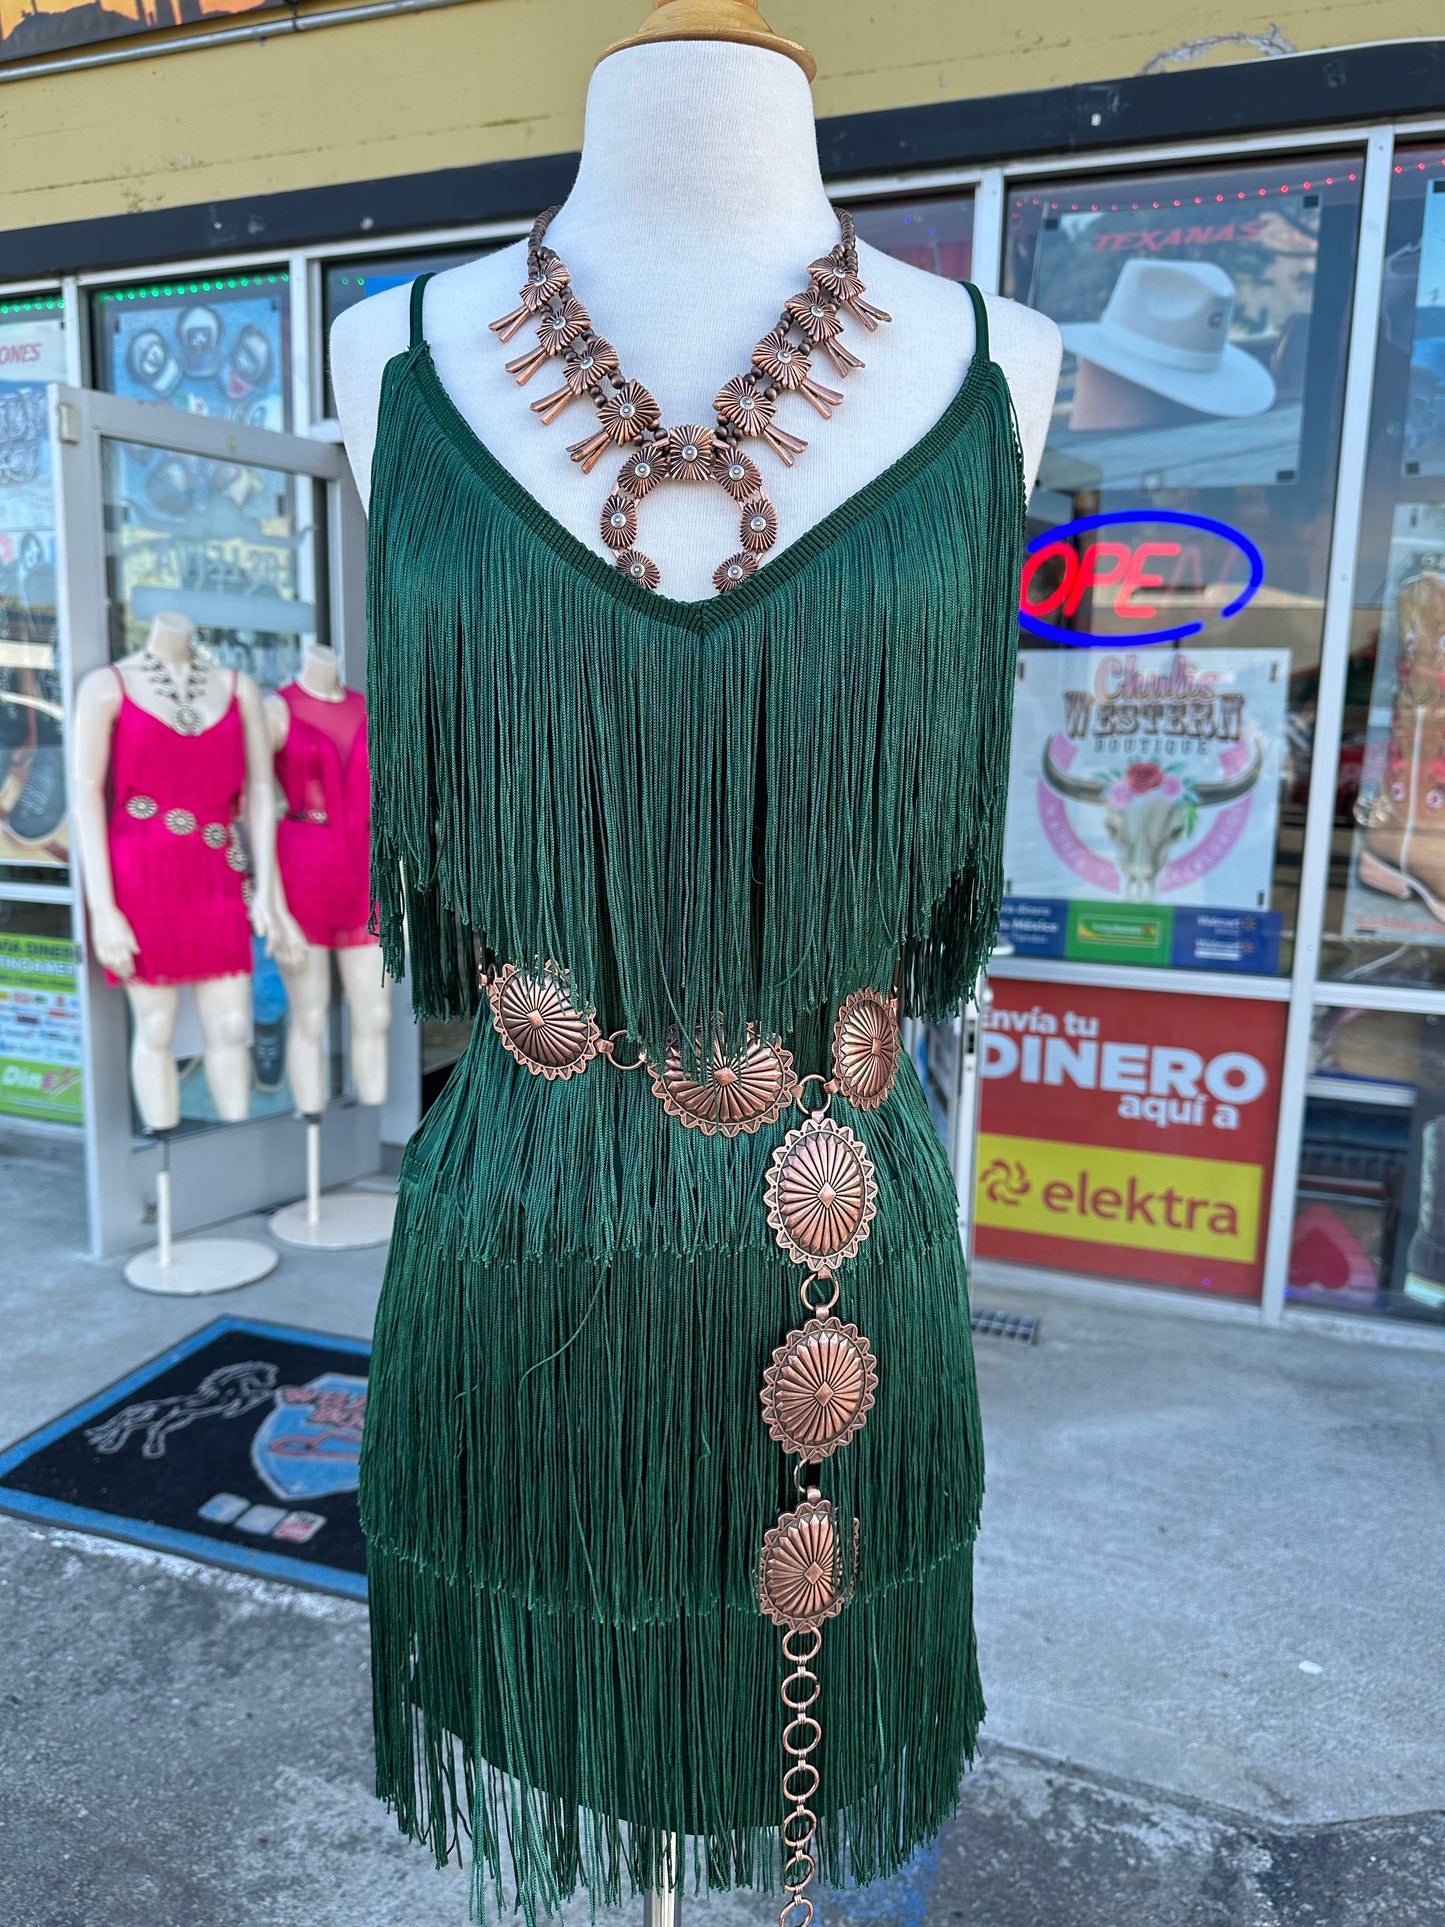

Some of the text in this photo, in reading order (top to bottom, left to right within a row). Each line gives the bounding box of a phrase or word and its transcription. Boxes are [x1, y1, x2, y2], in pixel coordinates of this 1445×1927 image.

[1095, 222, 1263, 252] TEXANAS
[1063, 691, 1246, 740] WESTERN
[1094, 738, 1208, 755] BOUTIQUE
[1064, 1011, 1099, 1038] tu
[980, 1031, 1268, 1105] DINERO
[1117, 1094, 1240, 1130] aquí a
[1041, 1169, 1239, 1237] elektra
